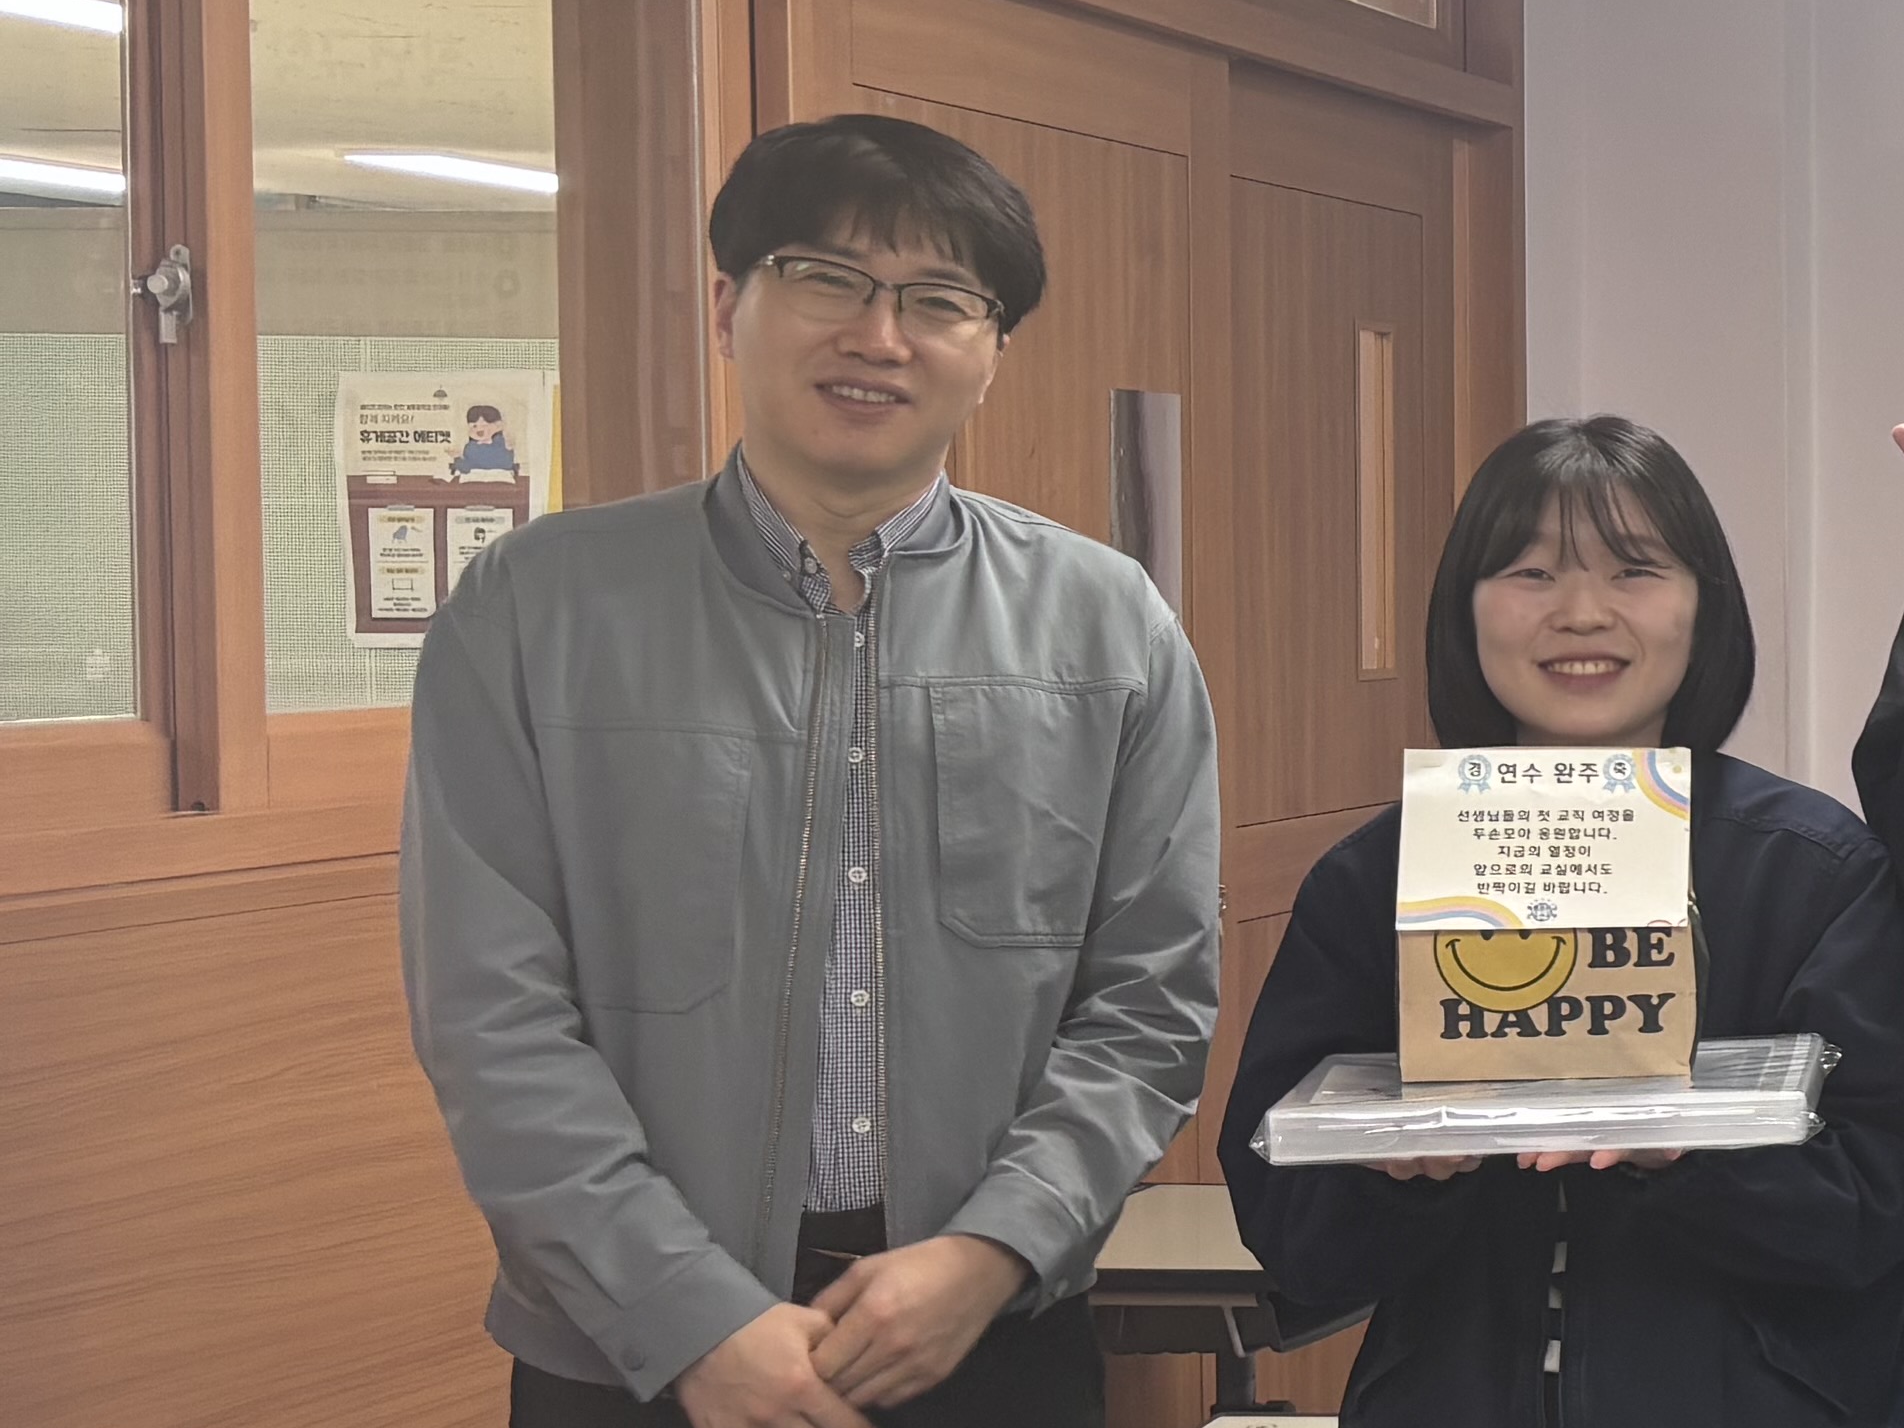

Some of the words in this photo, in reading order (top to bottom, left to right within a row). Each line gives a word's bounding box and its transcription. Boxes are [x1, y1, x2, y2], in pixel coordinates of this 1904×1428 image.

[1498, 763, 1542, 783] 연수
[1554, 763, 1600, 783] 완주
[1457, 810, 1530, 822] 선생님들의
[1538, 810, 1550, 822] 첫
[1557, 810, 1584, 822] 교직
[1592, 809, 1634, 822] 여정을
[1473, 828, 1531, 840] 두손모아
[1539, 827, 1617, 840] 응원합니다.
[1498, 846, 1540, 858] 지금의
[1548, 845, 1590, 858] 열정이
[1474, 864, 1532, 876] 앞으로의
[1540, 864, 1612, 876] 교실에서도
[1543, 882, 1607, 894] 바랍니다.
[1588, 926, 1676, 969] BE
[1440, 992, 1676, 1040] HAPPY
